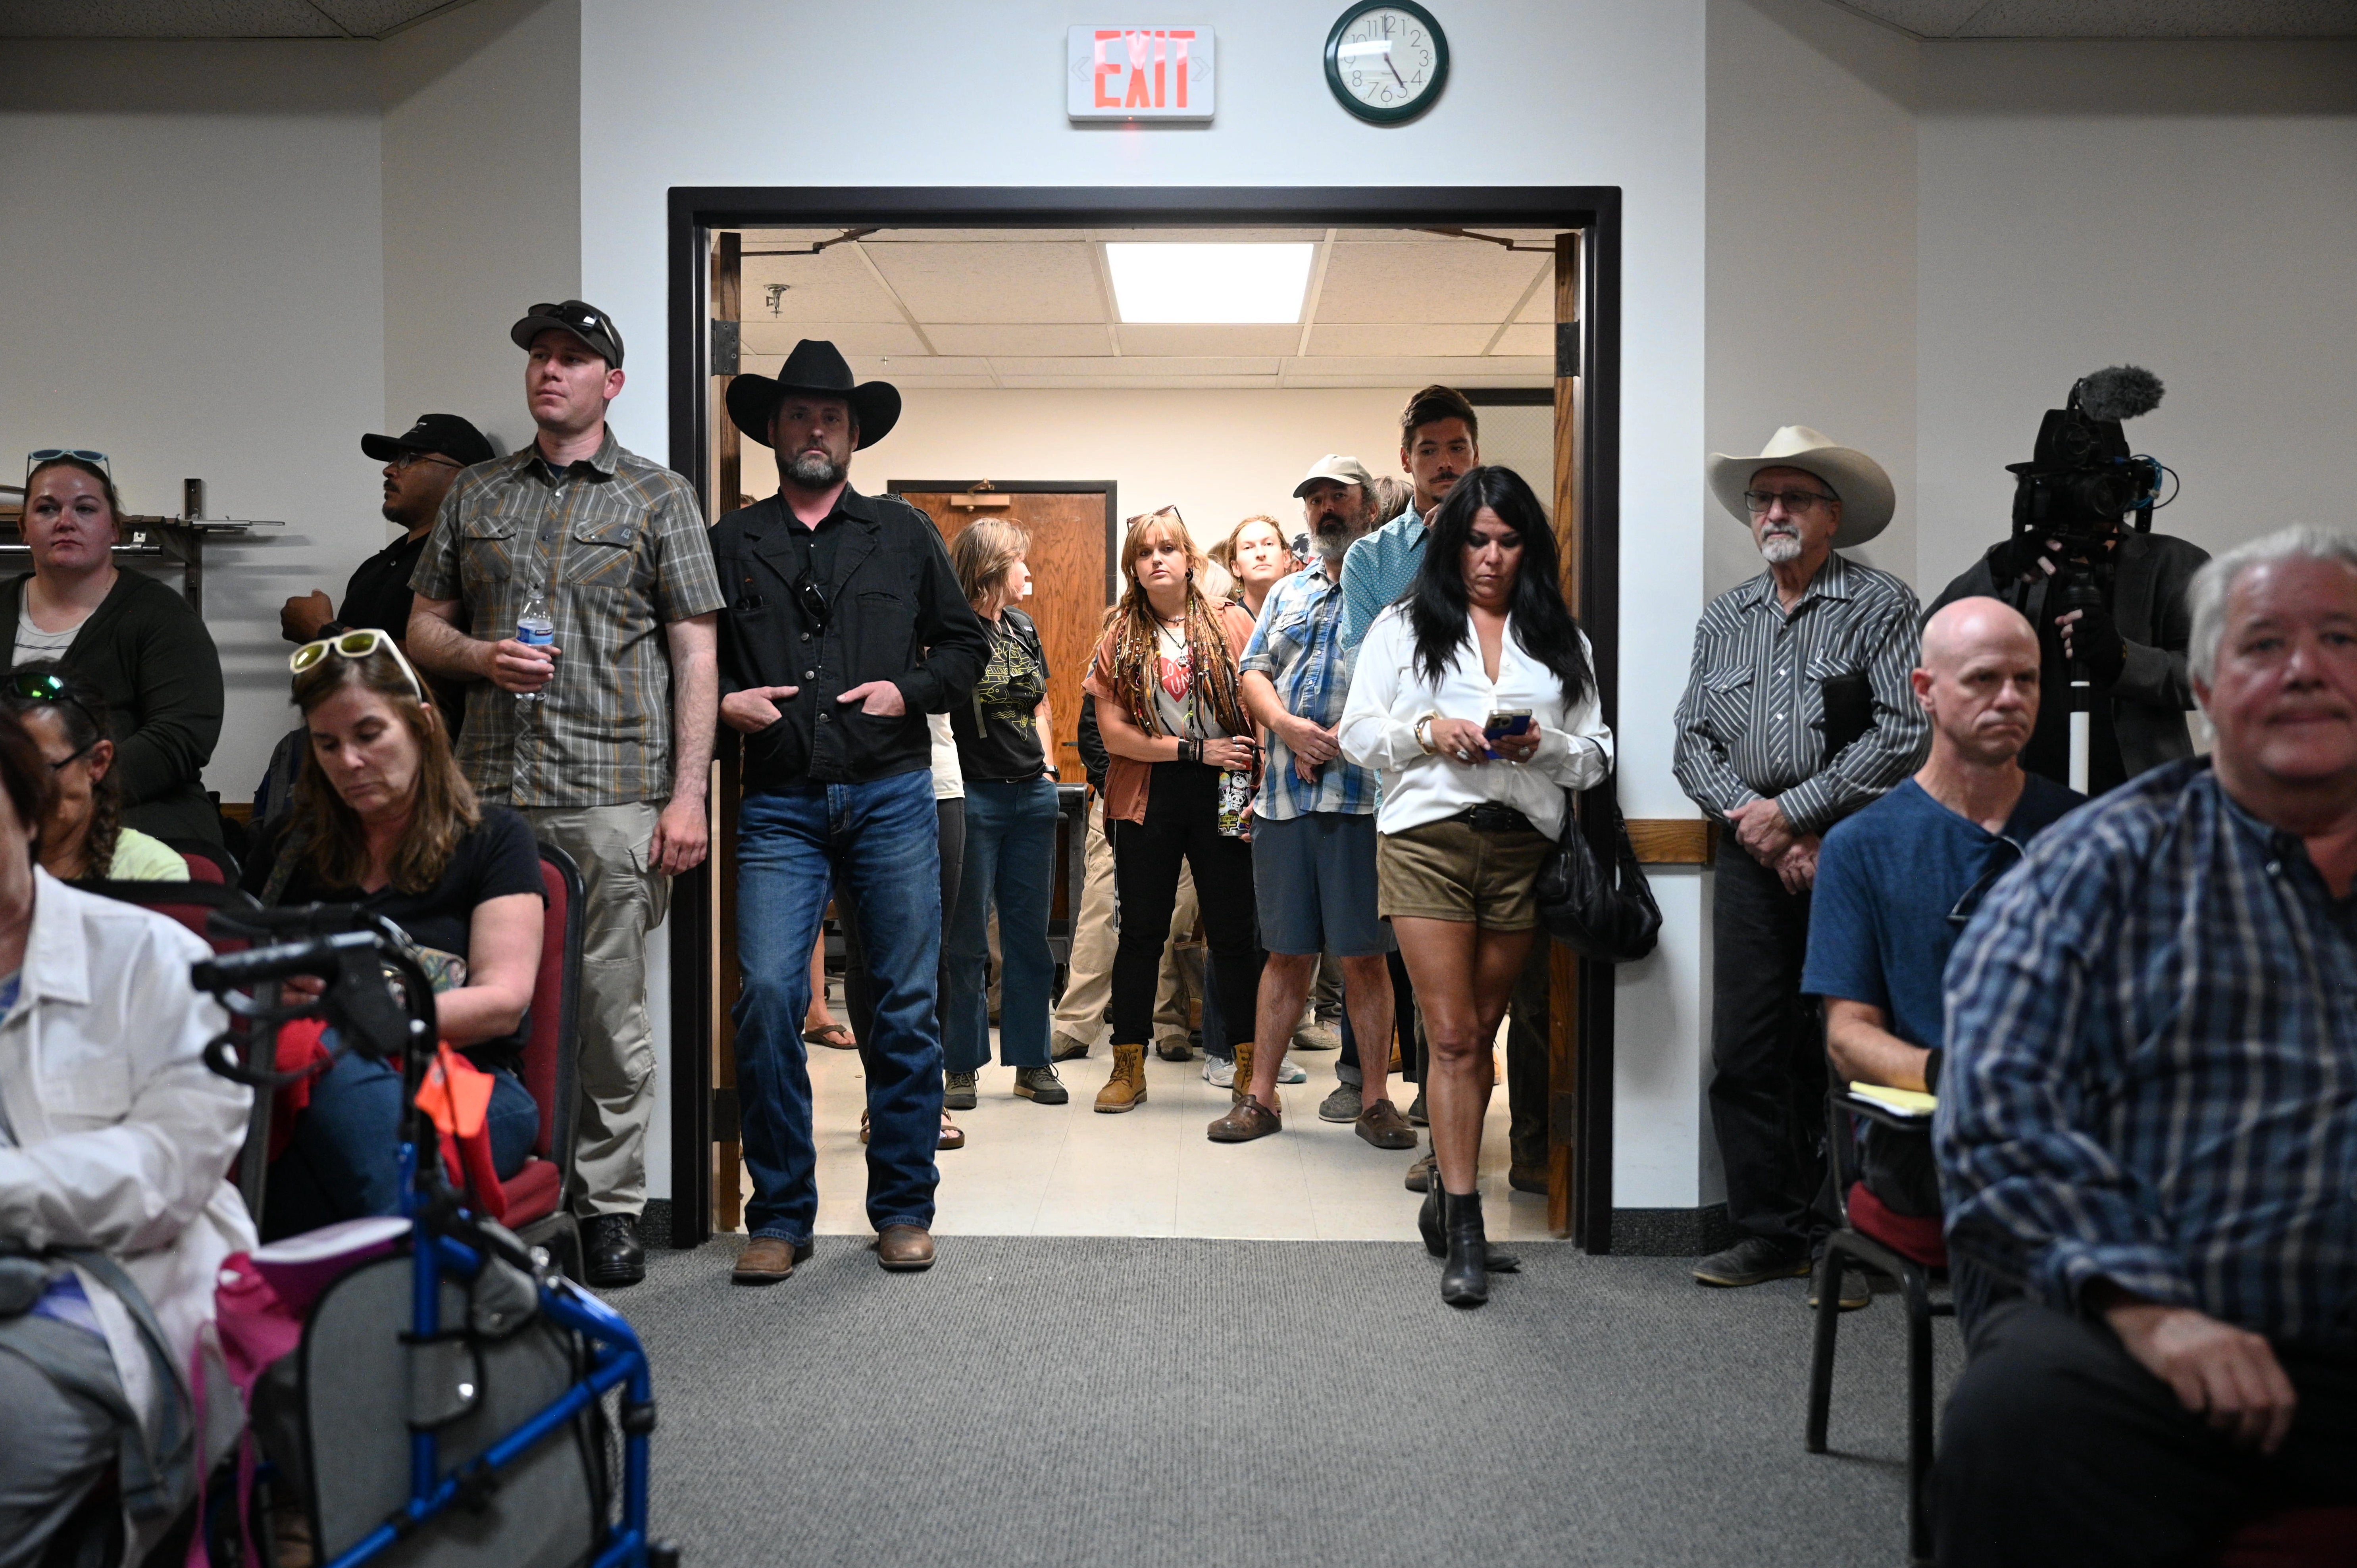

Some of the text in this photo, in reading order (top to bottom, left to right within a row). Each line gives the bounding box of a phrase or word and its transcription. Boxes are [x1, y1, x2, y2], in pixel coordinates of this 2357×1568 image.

[1367, 20, 1377, 37] 11
[1380, 16, 1395, 33] 12
[1401, 19, 1405, 36] 1
[1410, 30, 1420, 47] 2
[1419, 50, 1428, 67] 3
[1094, 30, 1195, 108] EXIT
[1411, 69, 1422, 86] 4
[1352, 70, 1362, 87] 8
[1368, 82, 1379, 98] 7
[1380, 85, 1392, 102] 6
[1397, 81, 1408, 98] 5
